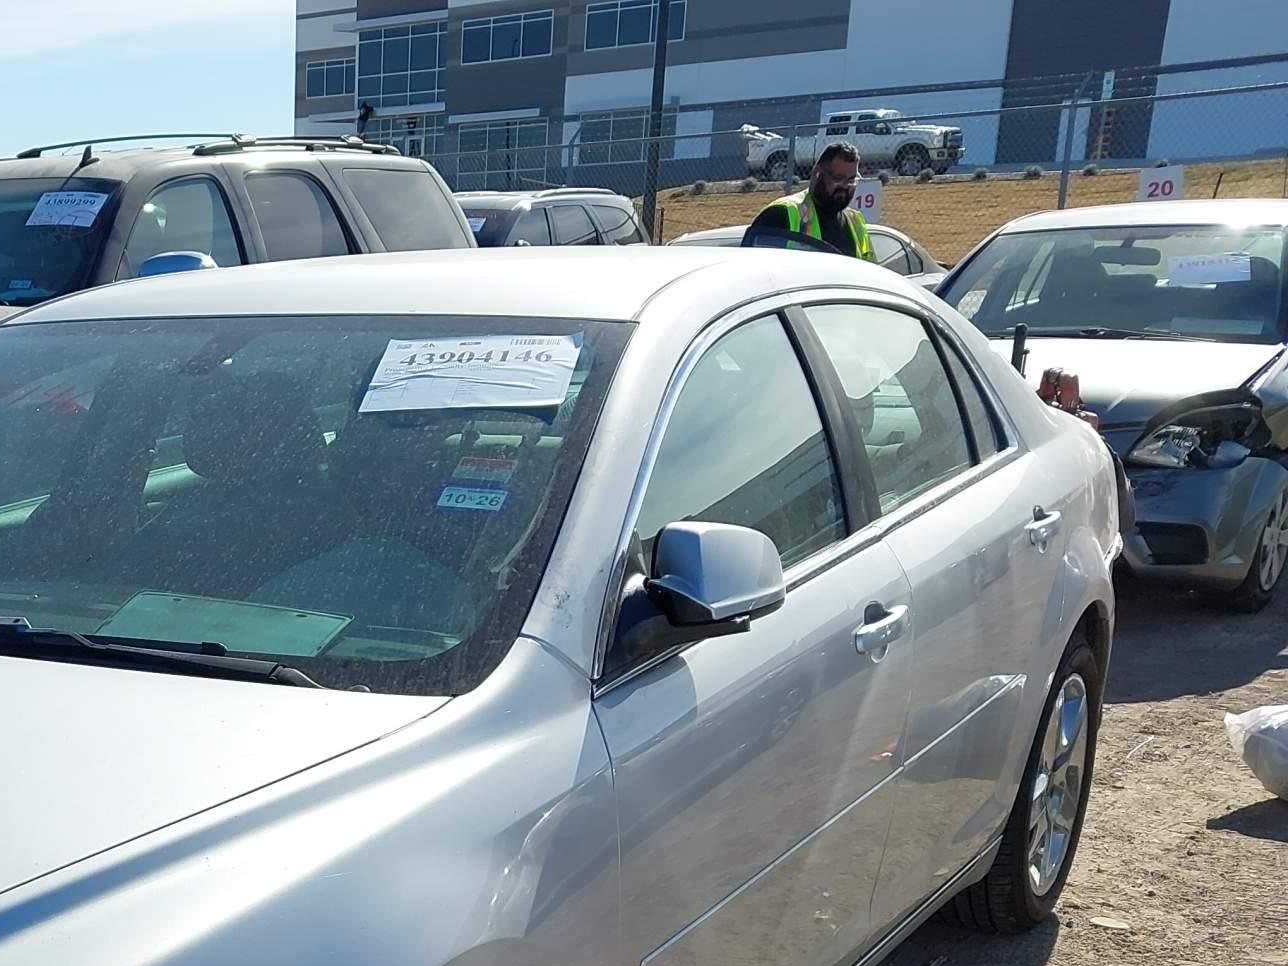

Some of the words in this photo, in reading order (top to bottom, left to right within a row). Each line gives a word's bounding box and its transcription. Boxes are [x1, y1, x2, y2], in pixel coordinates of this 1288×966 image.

[1147, 180, 1174, 198] 20
[855, 194, 875, 209] 19
[399, 348, 553, 366] 43904146
